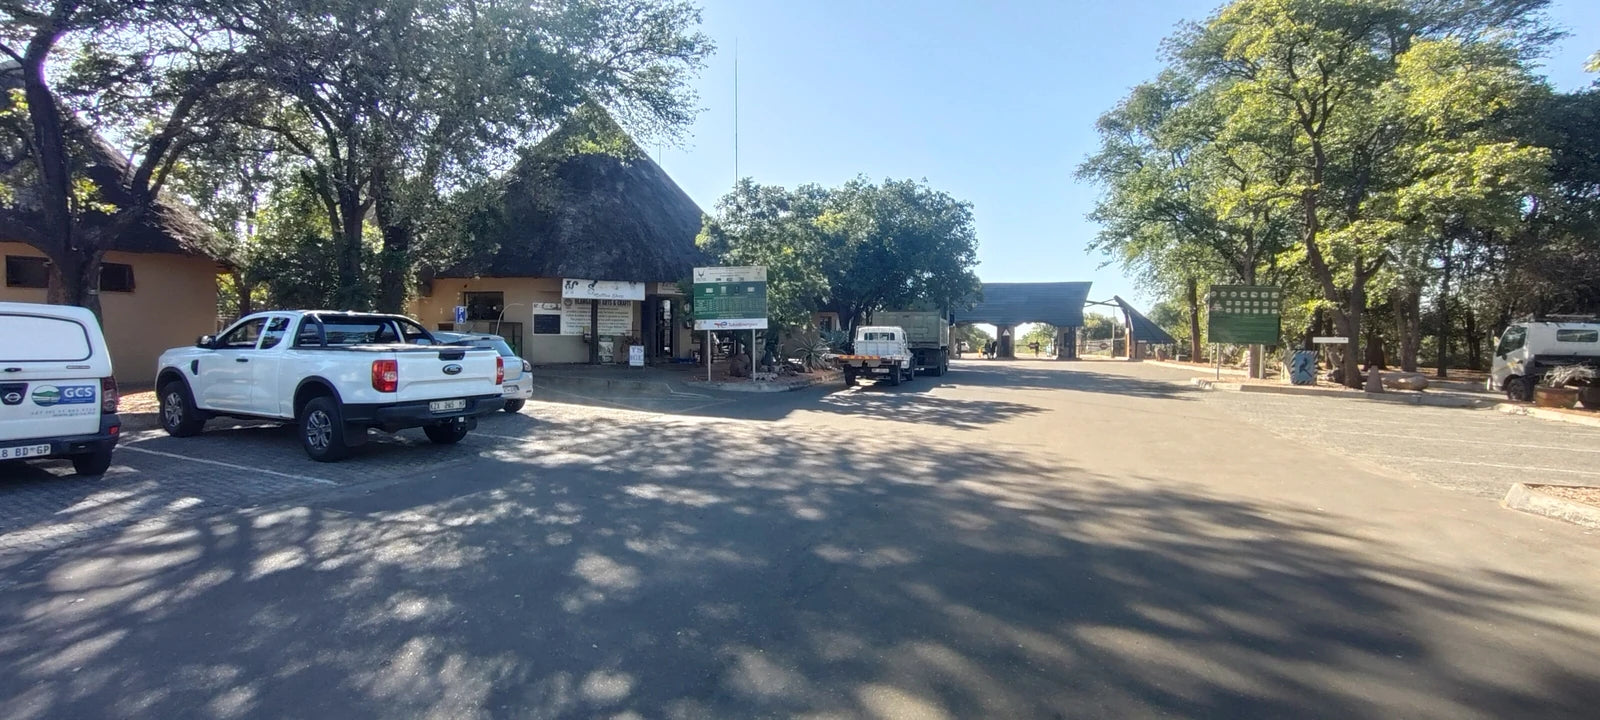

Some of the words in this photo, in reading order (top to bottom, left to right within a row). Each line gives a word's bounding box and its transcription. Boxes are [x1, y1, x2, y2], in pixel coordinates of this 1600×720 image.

[63, 387, 93, 397] GCS
[14, 447, 29, 456] BD
[36, 445, 50, 455] GP
